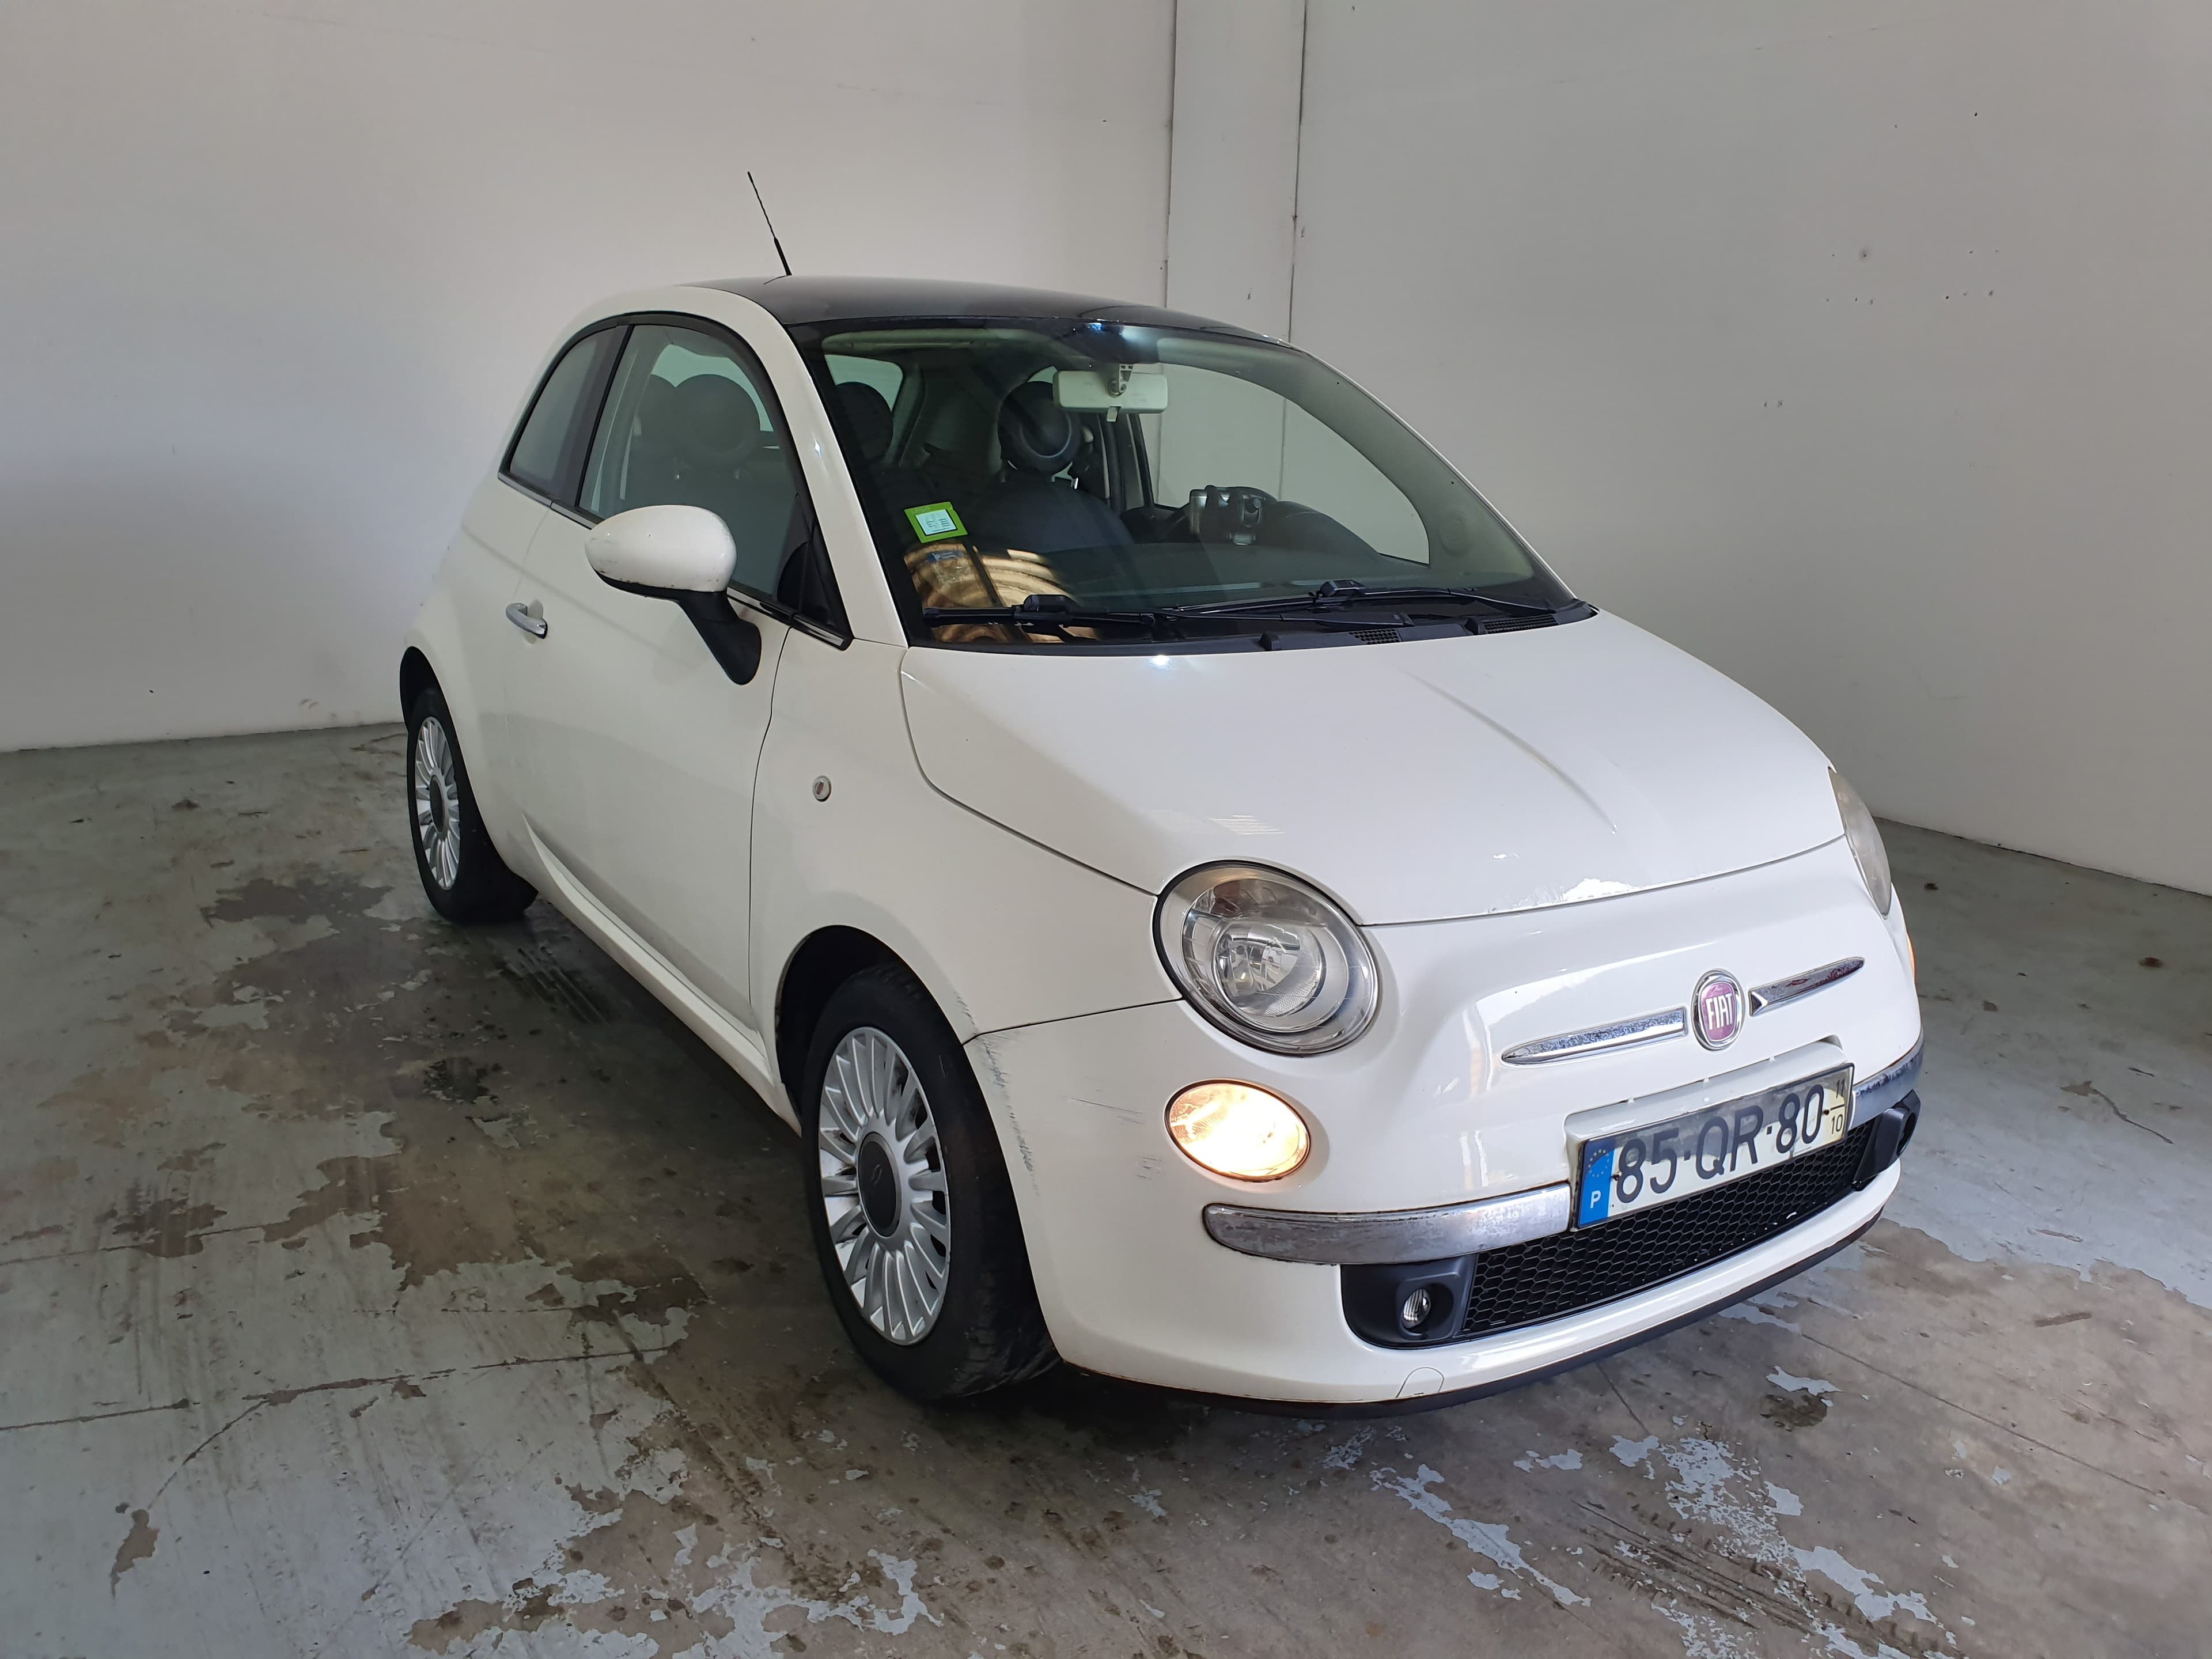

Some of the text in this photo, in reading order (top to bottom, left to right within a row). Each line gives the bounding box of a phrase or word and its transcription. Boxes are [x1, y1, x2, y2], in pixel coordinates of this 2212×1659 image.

[1706, 992, 1733, 1030] FIAT
[1831, 1113, 1844, 1134] 10
[1590, 1190, 1601, 1209] P
